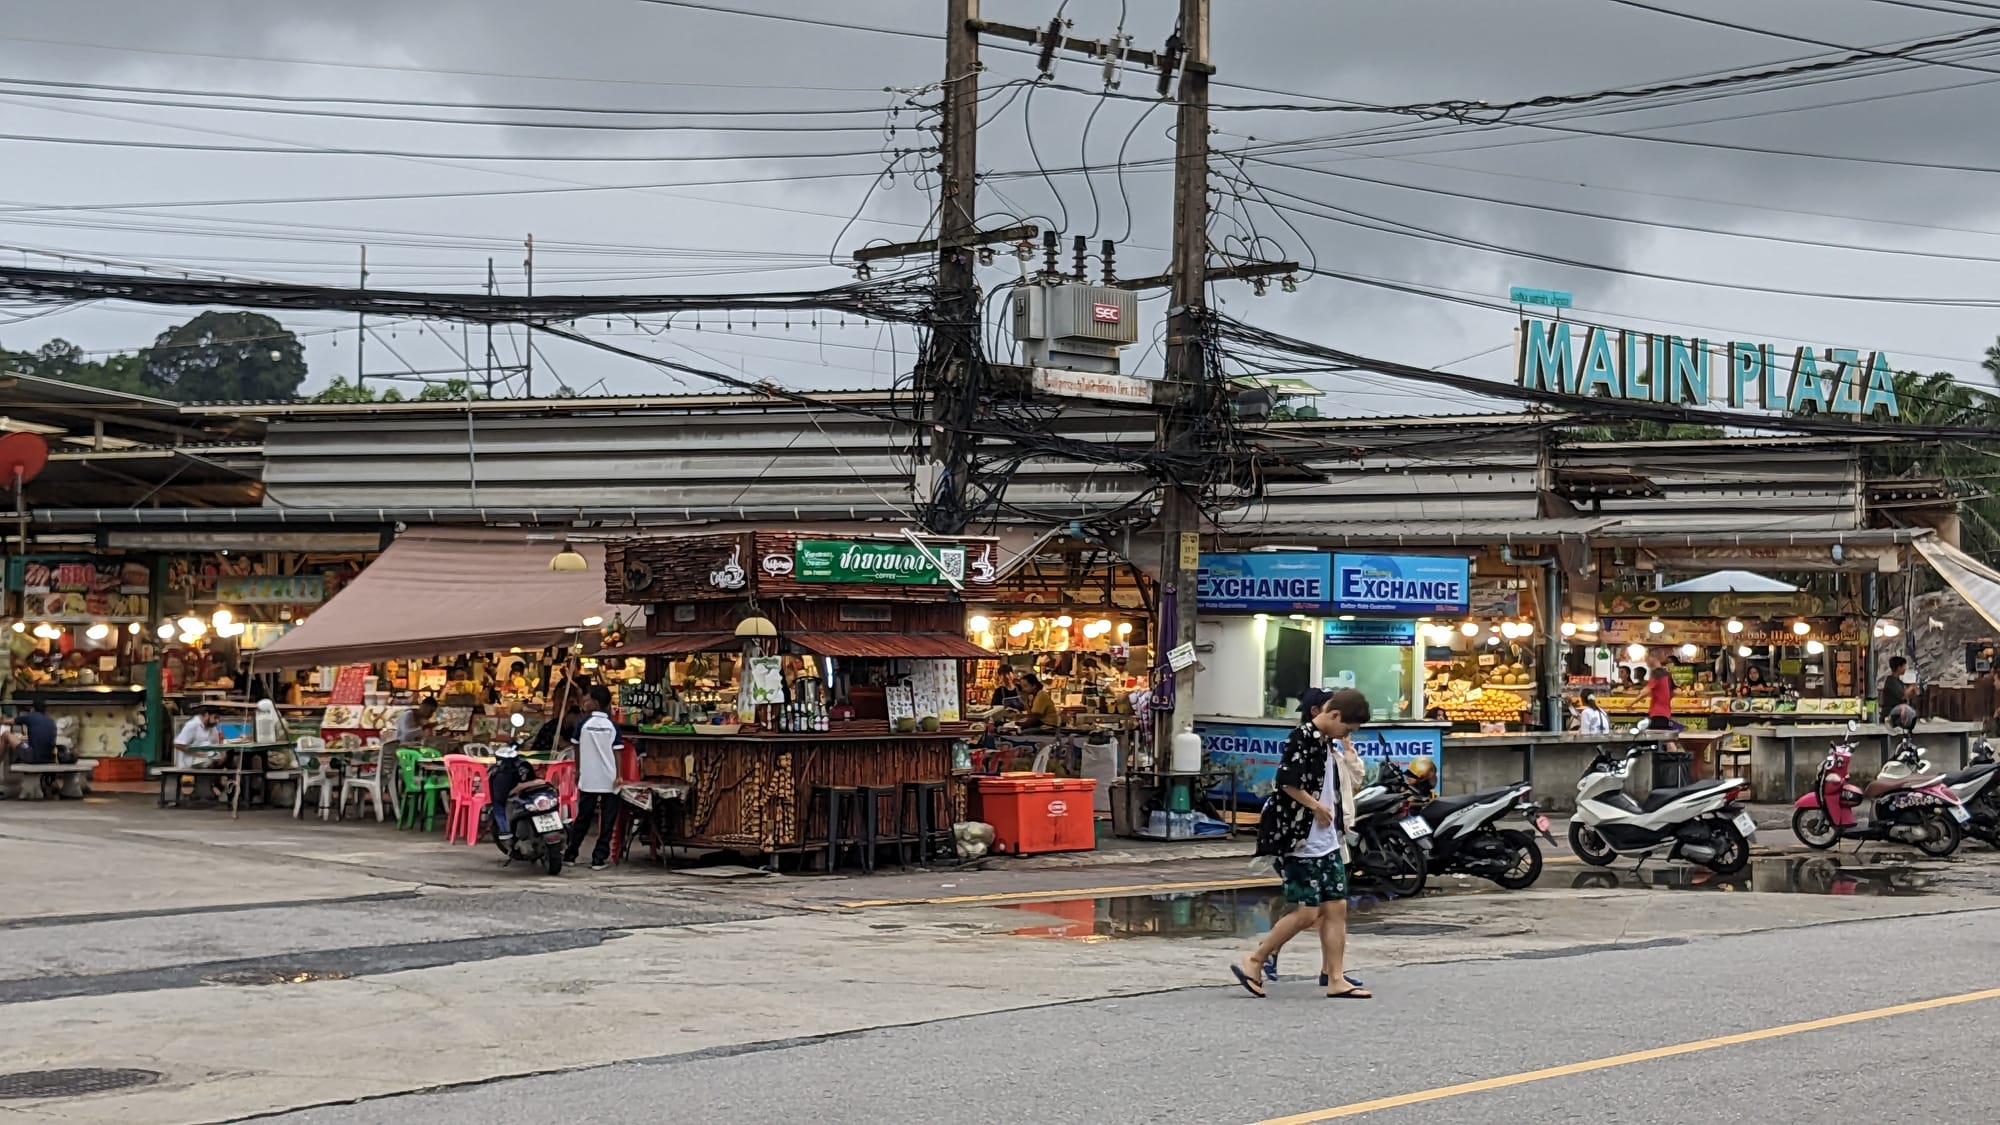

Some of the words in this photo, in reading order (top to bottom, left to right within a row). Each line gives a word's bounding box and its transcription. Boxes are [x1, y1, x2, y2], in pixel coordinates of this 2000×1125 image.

[1095, 307, 1118, 320] SEC
[1521, 319, 1708, 406] MALIN
[1729, 340, 1899, 417] PLAZA
[1196, 567, 1320, 599] EXCHANGE
[1341, 567, 1459, 601] EXCHANGE
